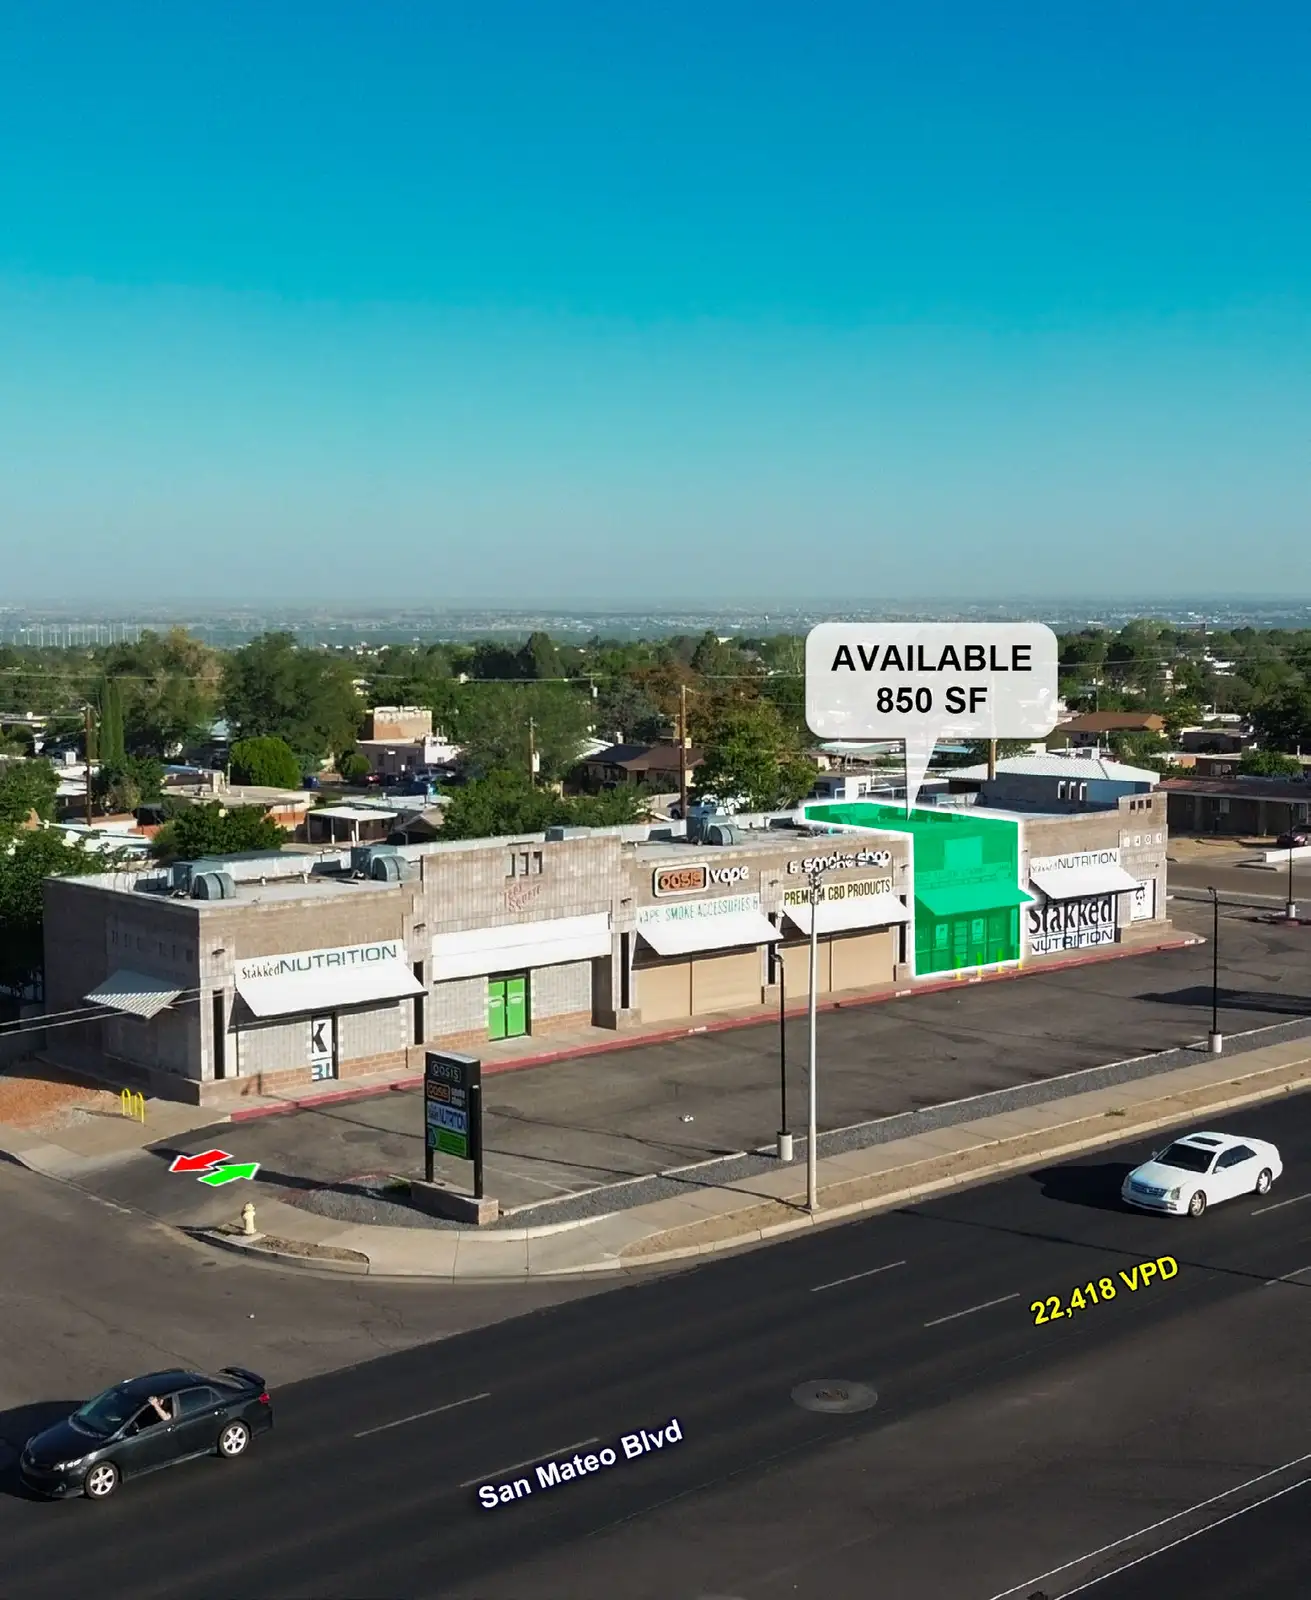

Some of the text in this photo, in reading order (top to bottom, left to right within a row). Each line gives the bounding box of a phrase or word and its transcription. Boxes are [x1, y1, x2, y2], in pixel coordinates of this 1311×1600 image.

[1057, 852, 1117, 869] NUTRITION
[710, 865, 750, 889] vape
[828, 886, 846, 900] CBD
[848, 879, 891, 898] PRODUCTS
[665, 904, 695, 921] SMOKE
[1032, 928, 1113, 952] NUTRITION
[280, 944, 398, 975] NUTRITION
